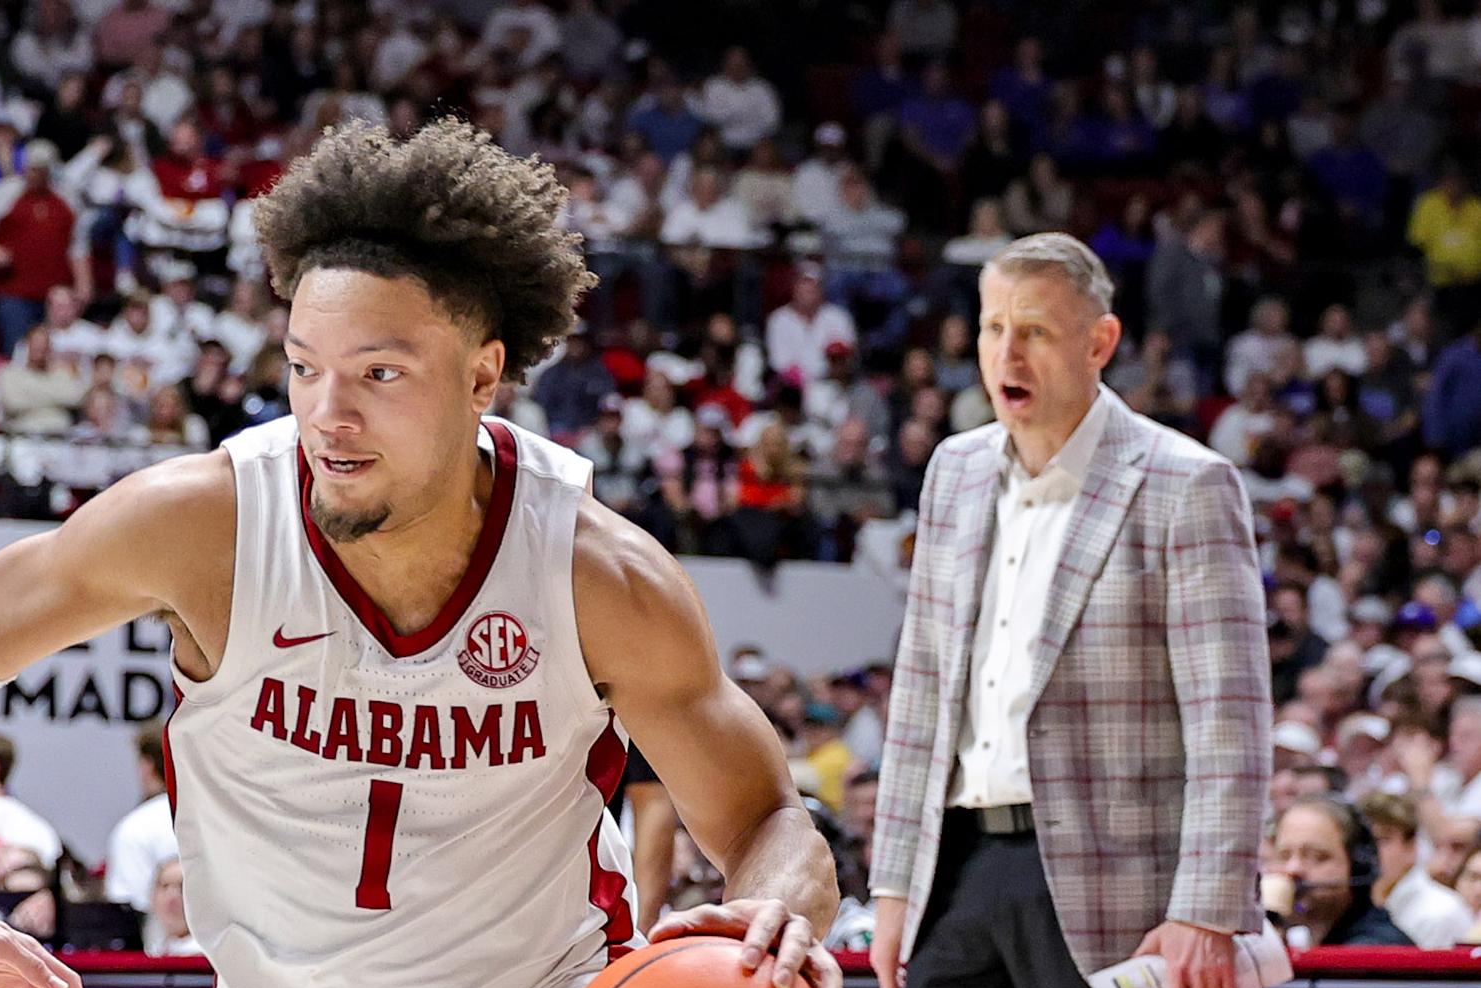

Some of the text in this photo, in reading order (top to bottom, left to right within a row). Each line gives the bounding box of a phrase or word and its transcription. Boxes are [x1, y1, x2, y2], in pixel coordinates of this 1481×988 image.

[469, 616, 525, 669] SEC
[4, 671, 165, 721] MAD
[465, 662, 531, 687] GRADUATE
[251, 677, 547, 770] ALABAMA
[355, 779, 404, 910] 1
